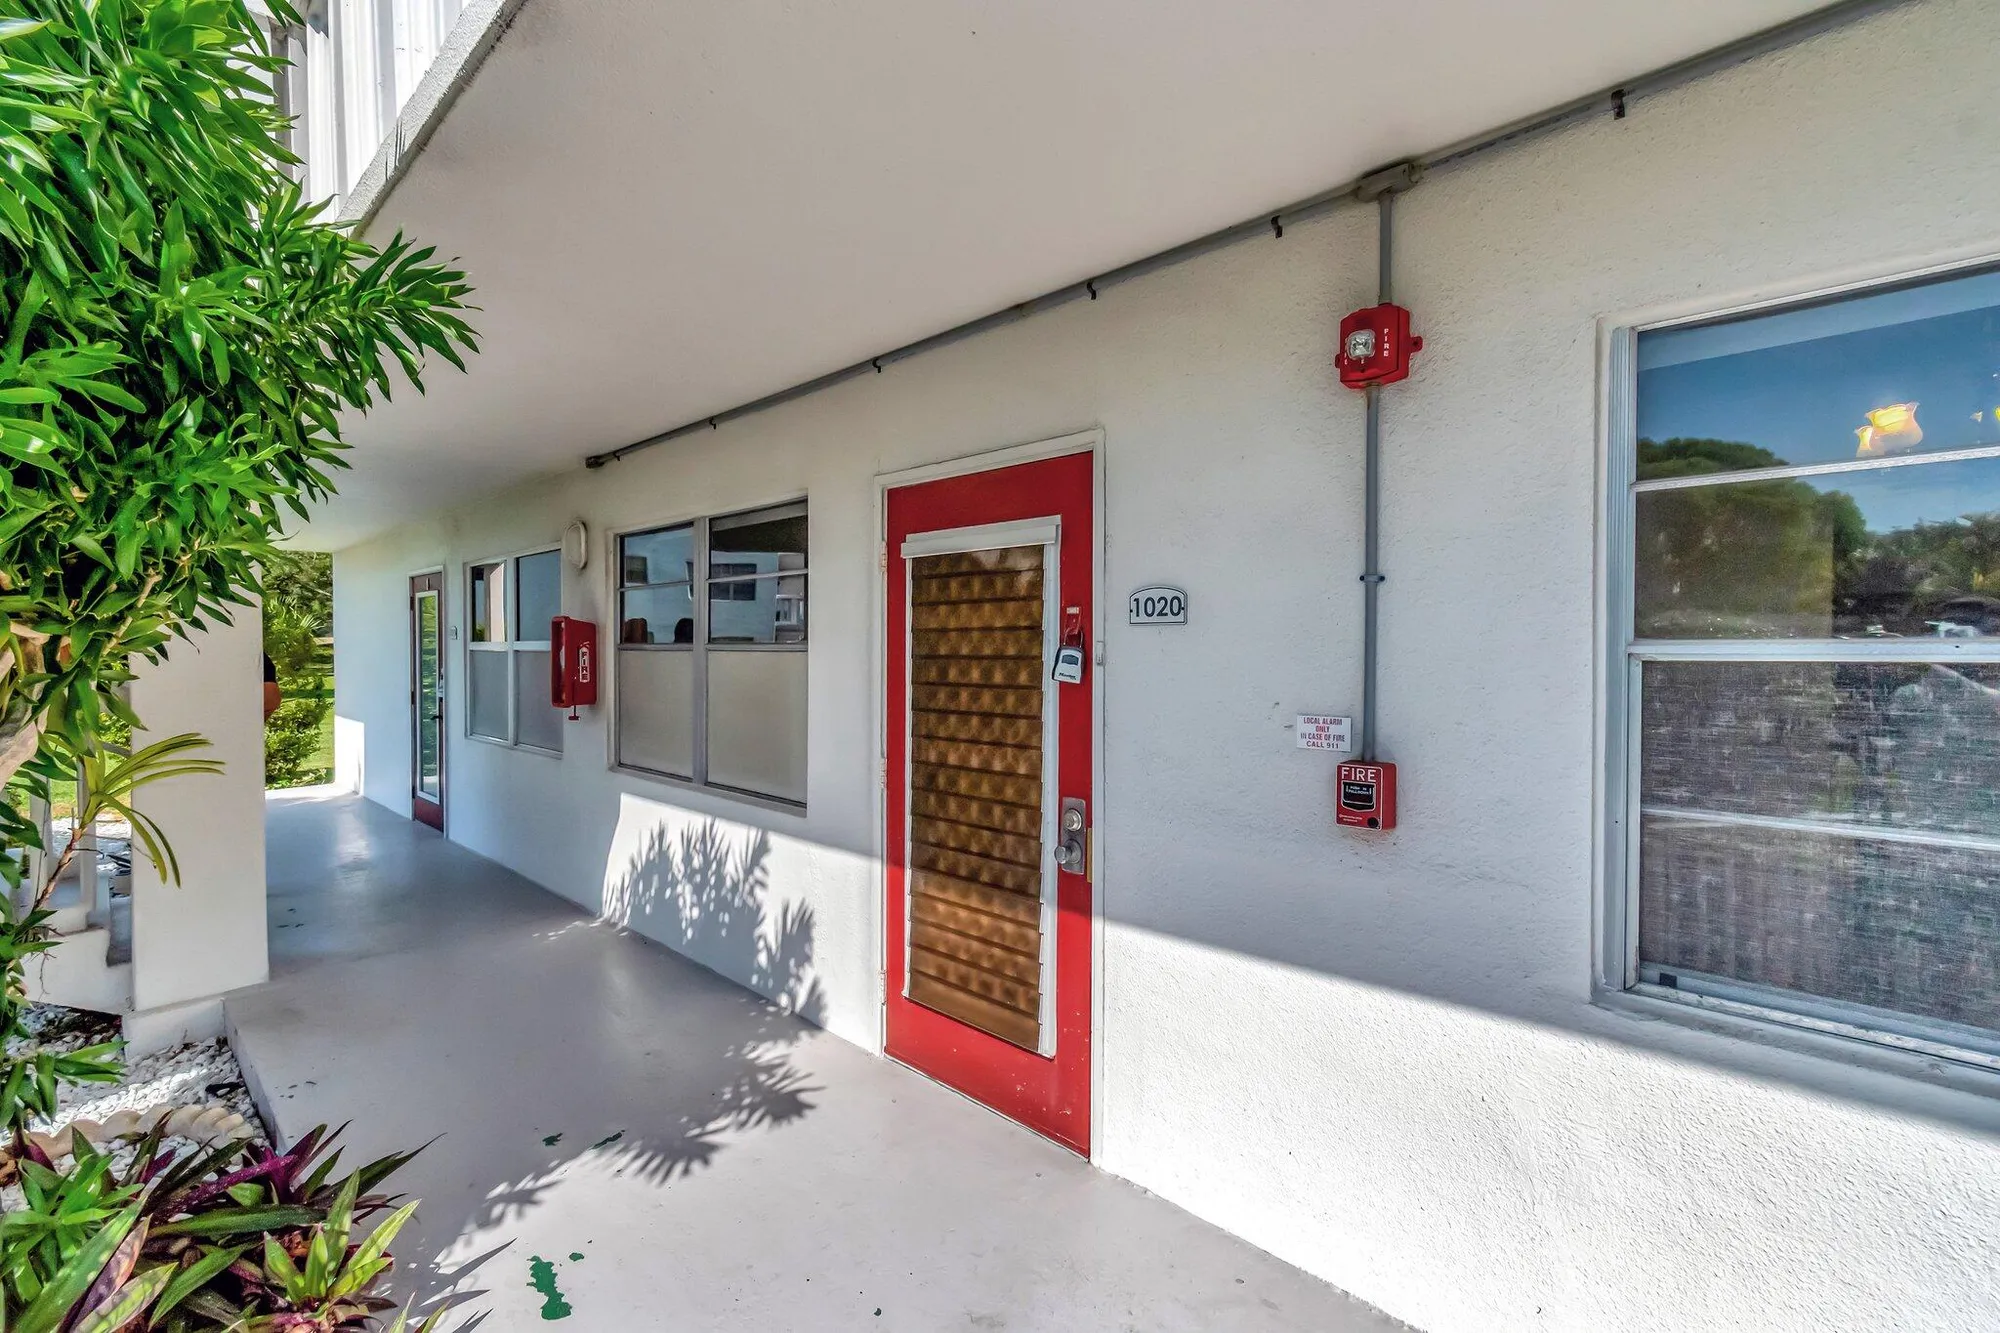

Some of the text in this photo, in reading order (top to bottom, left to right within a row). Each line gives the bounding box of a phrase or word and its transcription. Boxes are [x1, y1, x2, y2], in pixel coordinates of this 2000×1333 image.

[1133, 596, 1182, 617] 1020
[581, 651, 589, 681] FIRE
[1303, 716, 1342, 726] LOCAL ALARM
[1315, 725, 1330, 733] ONLY
[1300, 732, 1307, 740] IN
[1308, 732, 1323, 741] CASE
[1332, 734, 1345, 742] FIRE
[1306, 740, 1325, 748] CALL
[1341, 767, 1377, 783] FIRE
